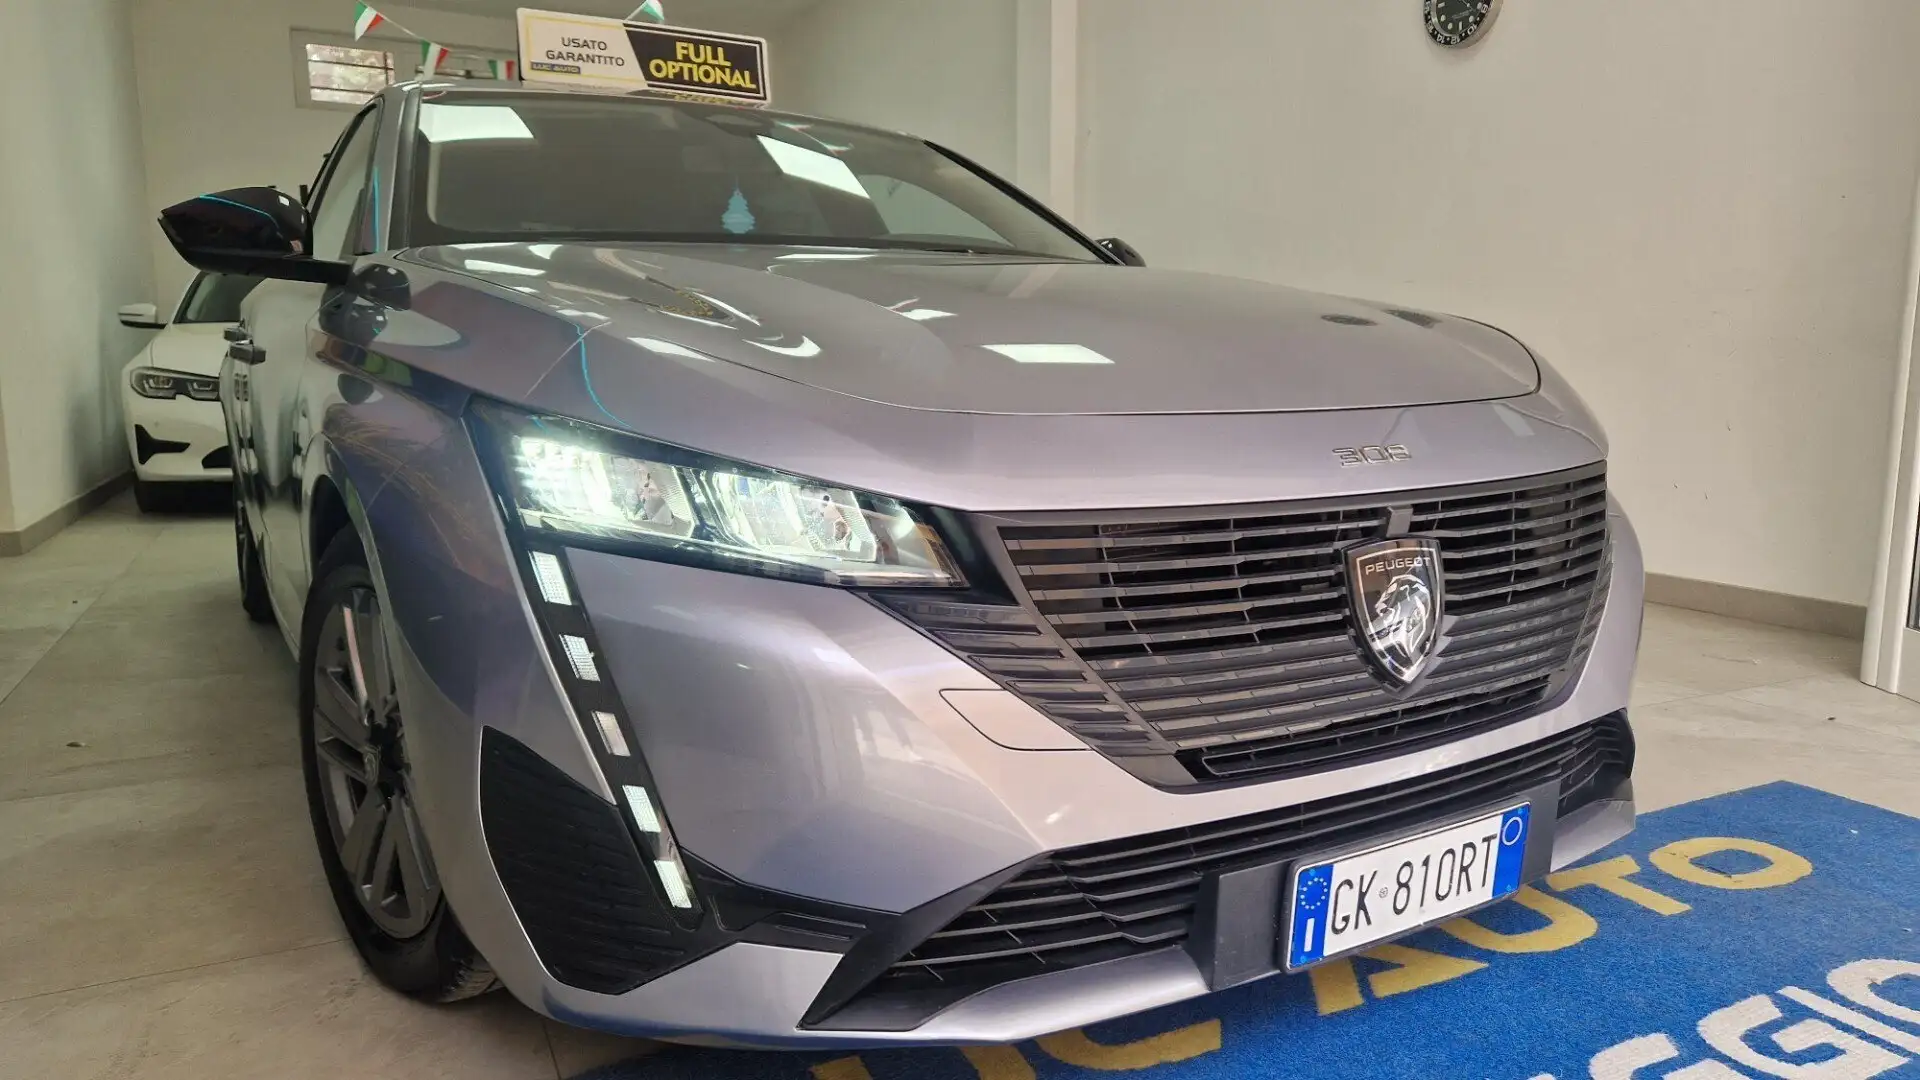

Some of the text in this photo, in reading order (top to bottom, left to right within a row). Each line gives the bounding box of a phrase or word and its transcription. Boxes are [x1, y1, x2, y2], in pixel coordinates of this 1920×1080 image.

[561, 36, 608, 51] USATO
[675, 41, 732, 67] FULL
[546, 50, 625, 66] GARANTITO
[649, 59, 757, 89] OPTIONAL
[1332, 444, 1412, 467] 308
[1365, 557, 1431, 575] PEUGEOT
[1331, 870, 1378, 935] GK
[1392, 833, 1498, 916] 810RT
